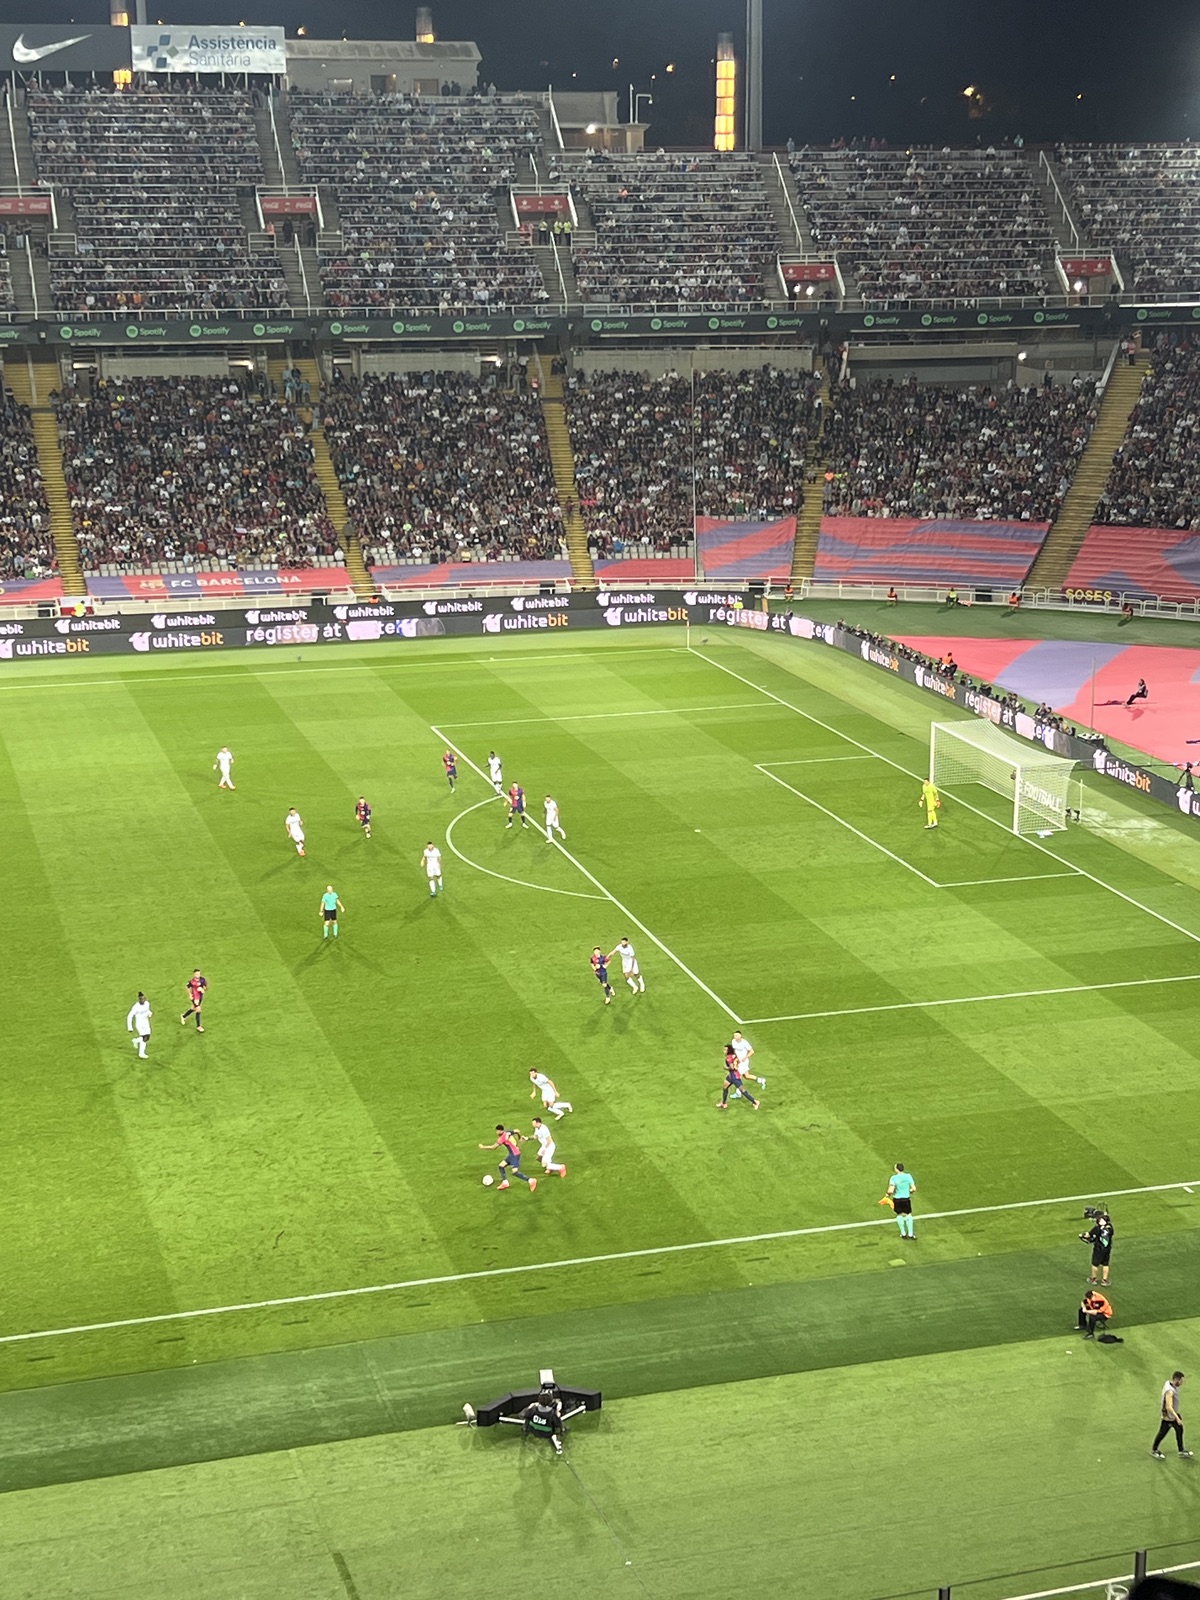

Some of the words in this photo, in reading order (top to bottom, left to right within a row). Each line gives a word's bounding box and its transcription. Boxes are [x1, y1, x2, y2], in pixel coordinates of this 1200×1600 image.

[188, 34, 277, 50] Assistència
[189, 51, 251, 67] Sanitària
[266, 325, 293, 334] Spotify
[343, 324, 370, 333] Spotify
[405, 323, 432, 332] Spotify
[465, 322, 492, 331] Spotify
[526, 321, 552, 330] Spotify
[603, 321, 629, 330] Spotify
[662, 320, 688, 328] Spotify
[720, 319, 746, 328] Spotify
[74, 328, 101, 337] Spotify
[139, 328, 167, 336] Spotify
[202, 326, 230, 335] Spotify
[171, 579, 193, 588] FC
[197, 575, 302, 587] BARCELONA
[525, 597, 570, 609] whitebit
[610, 593, 656, 605] whitebit
[348, 605, 395, 618] whitebit
[437, 601, 483, 614] whitebit
[166, 614, 216, 627] whitebit
[624, 607, 689, 623] whitebit
[70, 618, 121, 632] whitebit
[503, 613, 569, 630] whitebit
[152, 631, 224, 649] whitebit
[16, 637, 90, 656] whitebit
[924, 673, 957, 700] whitebit
[1106, 761, 1152, 793] whitebit
